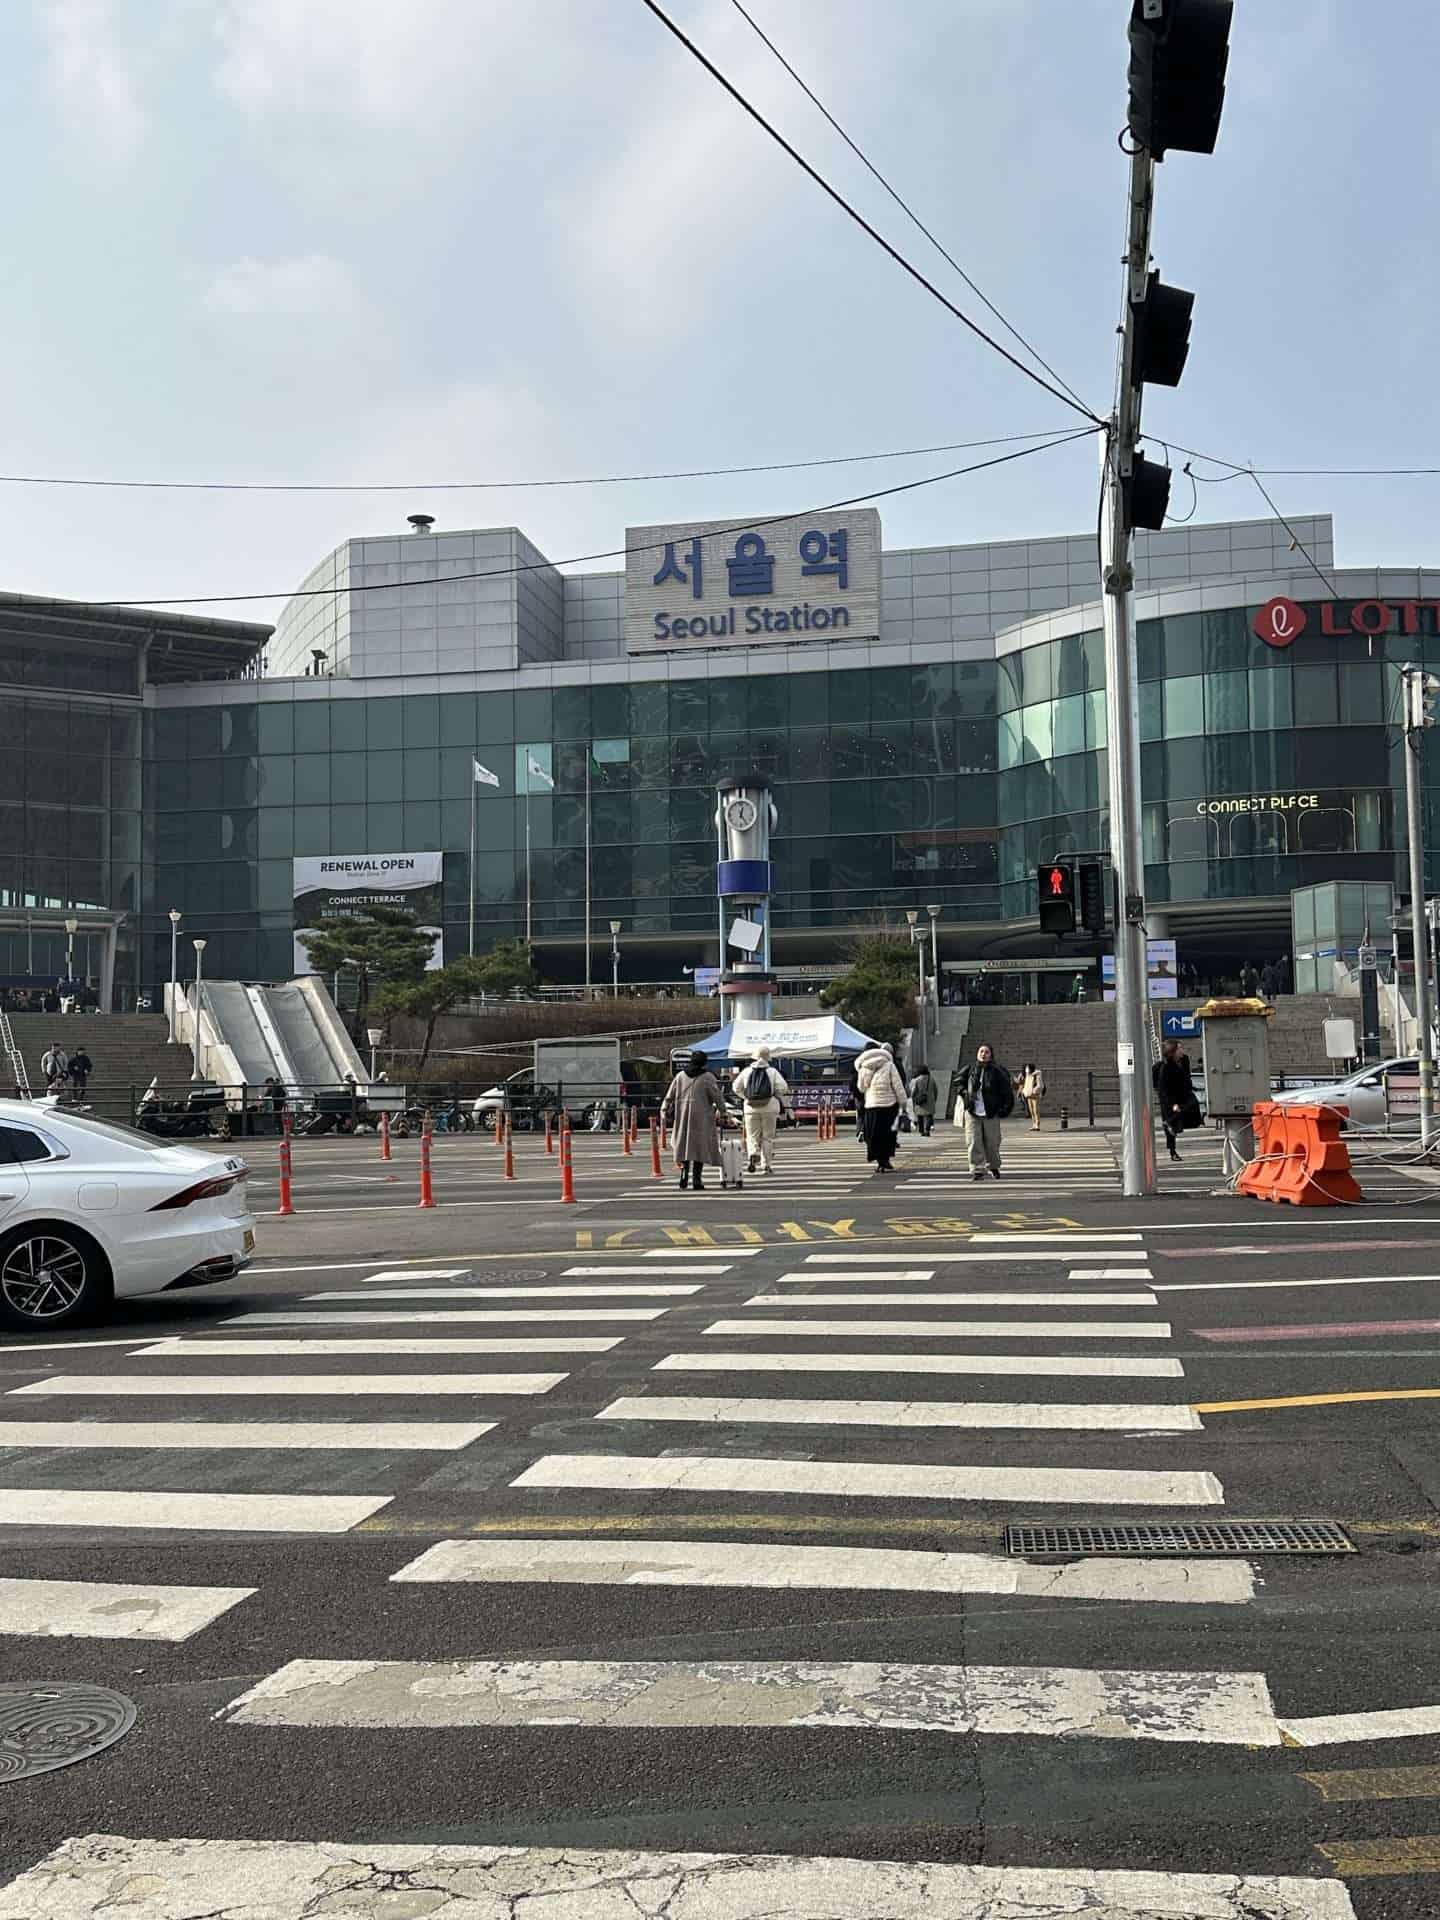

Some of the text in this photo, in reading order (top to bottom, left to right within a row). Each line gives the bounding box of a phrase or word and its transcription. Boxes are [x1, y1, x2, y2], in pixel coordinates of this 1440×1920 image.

[653, 528, 848, 599] 서울역
[654, 602, 849, 640] Seoul Station
[1320, 600, 1440, 634] LOT
[1197, 799, 1266, 815] CONNECT
[320, 858, 415, 872] RENEWAL OPEN
[328, 895, 406, 905] CONNECT TERRACE
[575, 1212, 1085, 1249] 보행자대기
